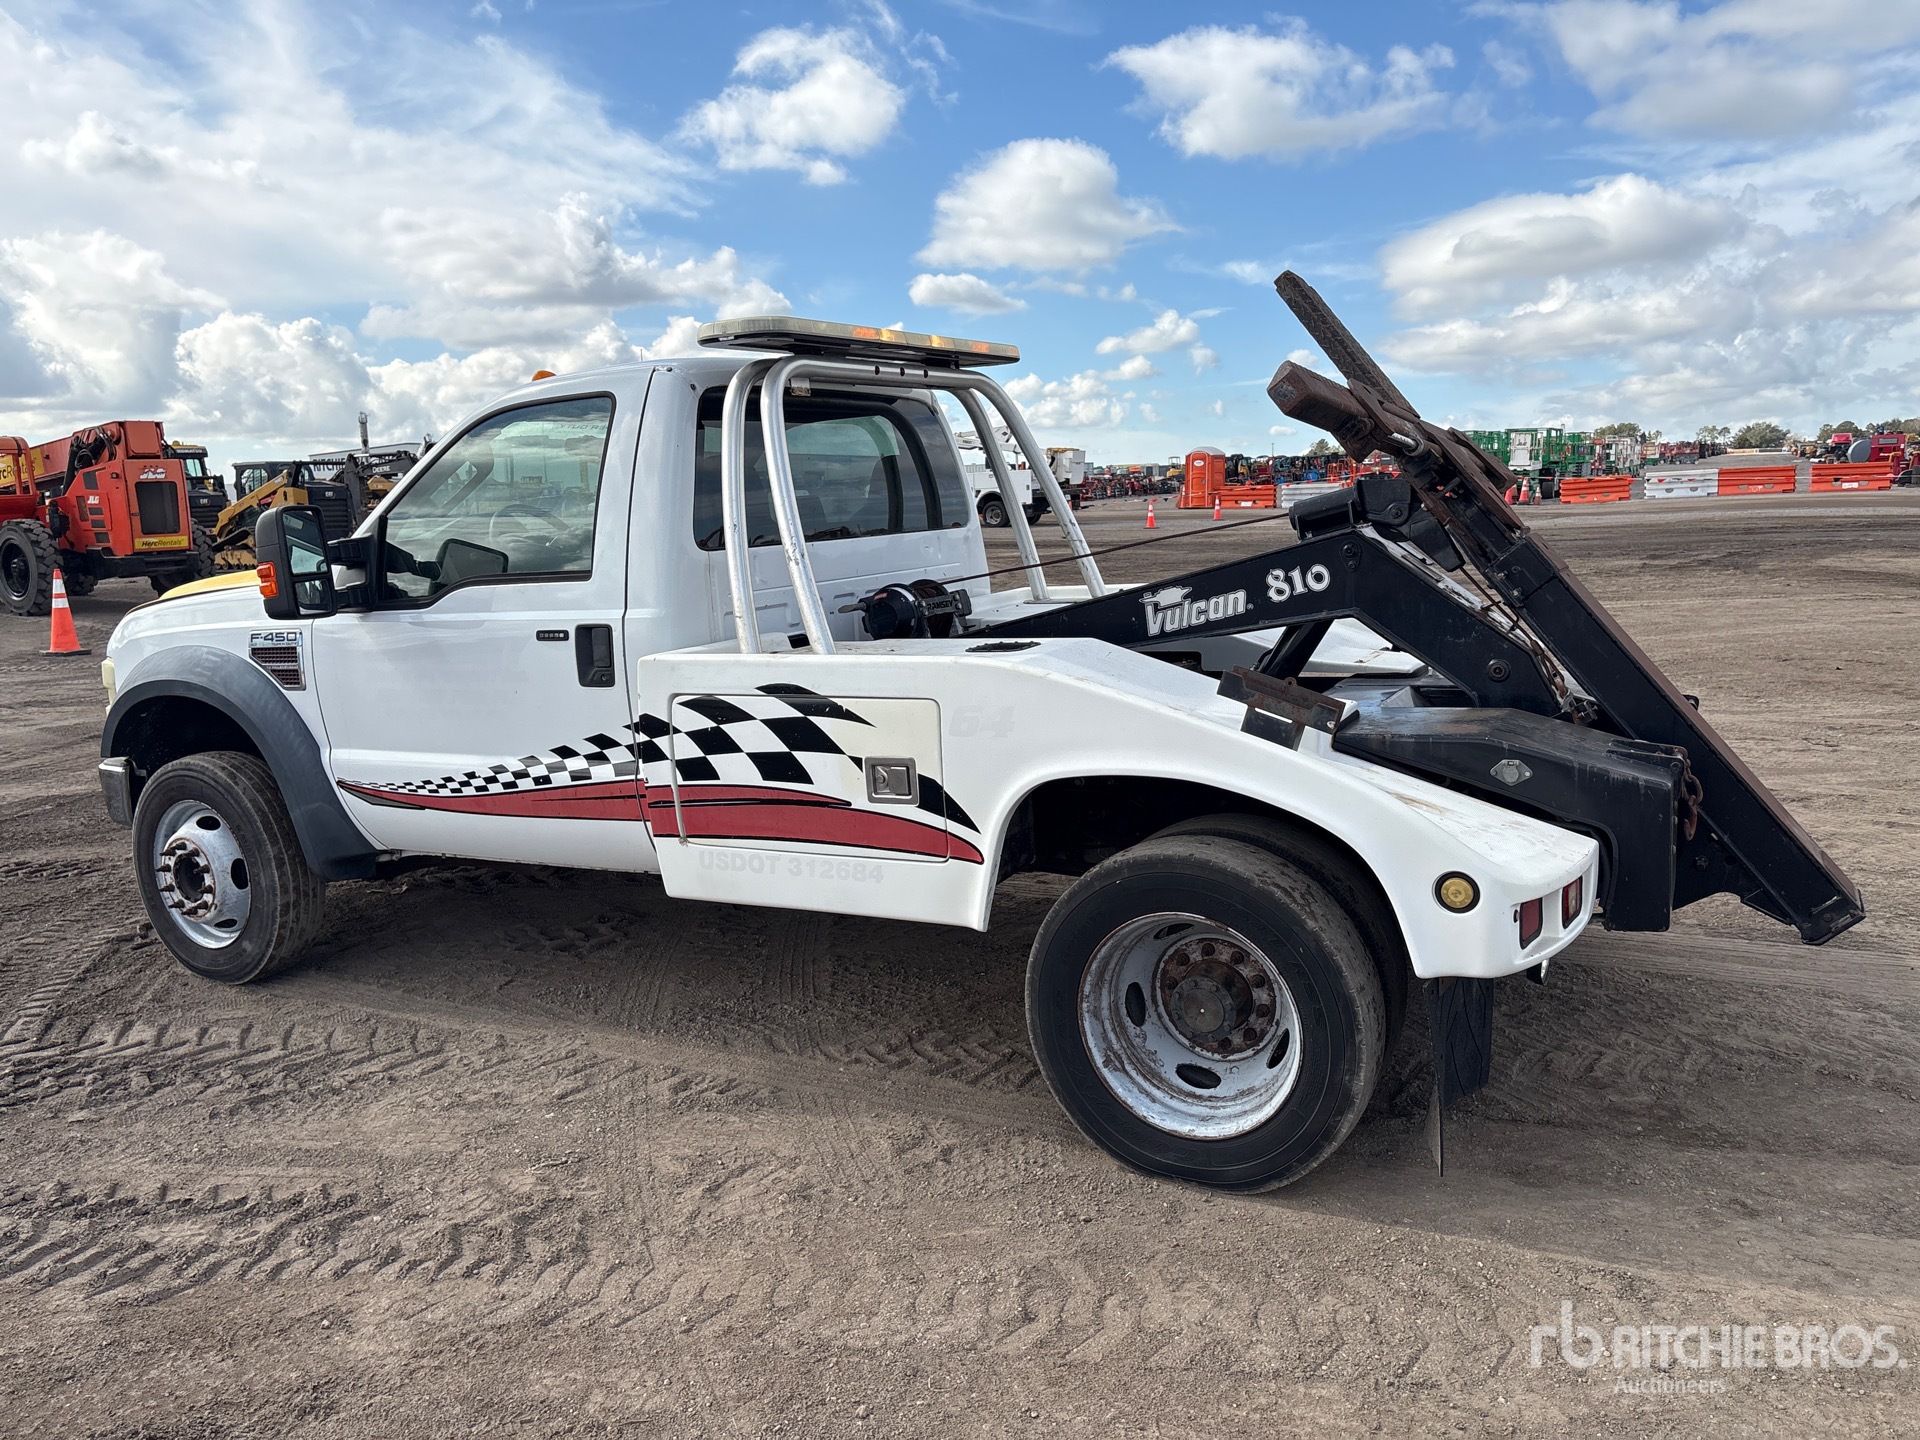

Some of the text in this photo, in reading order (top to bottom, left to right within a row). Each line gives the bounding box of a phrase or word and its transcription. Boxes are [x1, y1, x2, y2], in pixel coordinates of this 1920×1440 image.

[372, 465, 391, 474] DEERE
[87, 495, 100, 504] JLG
[1265, 563, 1331, 603] 810
[927, 599, 954, 612] RAMSEY
[1143, 587, 1248, 637] Vulcan
[948, 704, 1016, 738] 64
[699, 850, 884, 884] USDOT 312684
